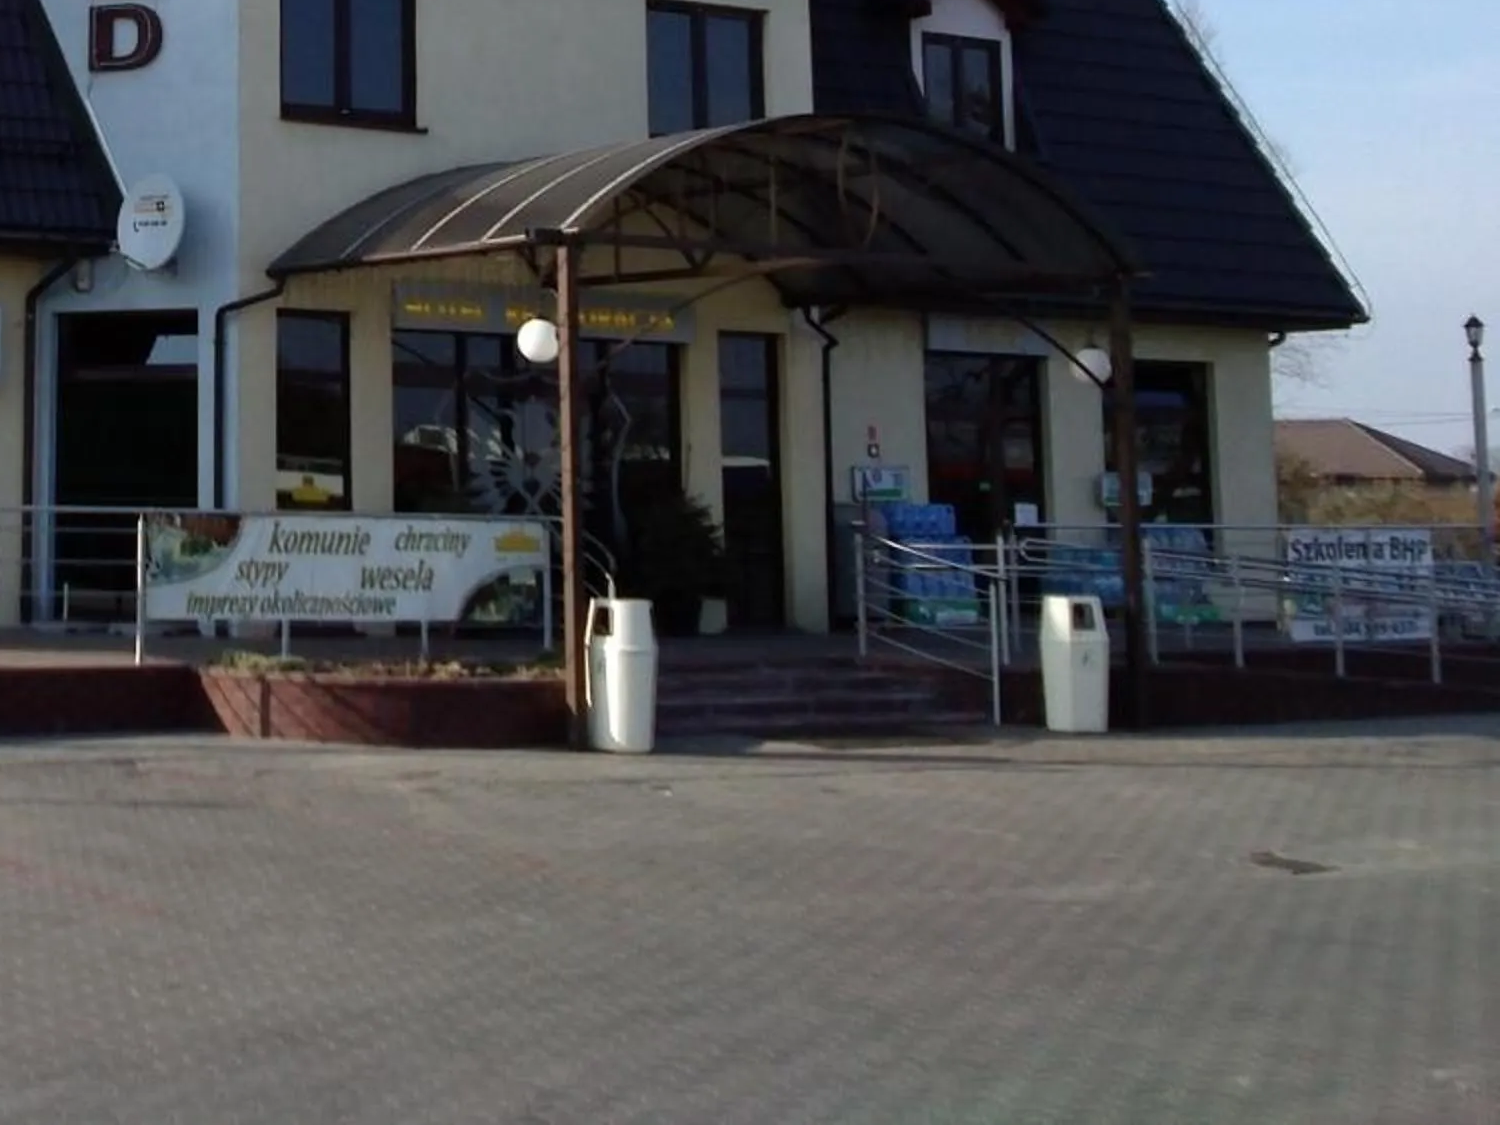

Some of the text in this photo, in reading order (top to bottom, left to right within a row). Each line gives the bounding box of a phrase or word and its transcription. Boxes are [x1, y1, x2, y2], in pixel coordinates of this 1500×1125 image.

[268, 521, 471, 558] komunie chrzciny
[1290, 536, 1428, 562] Szkolena BHP
[235, 558, 435, 592] stypy wesela
